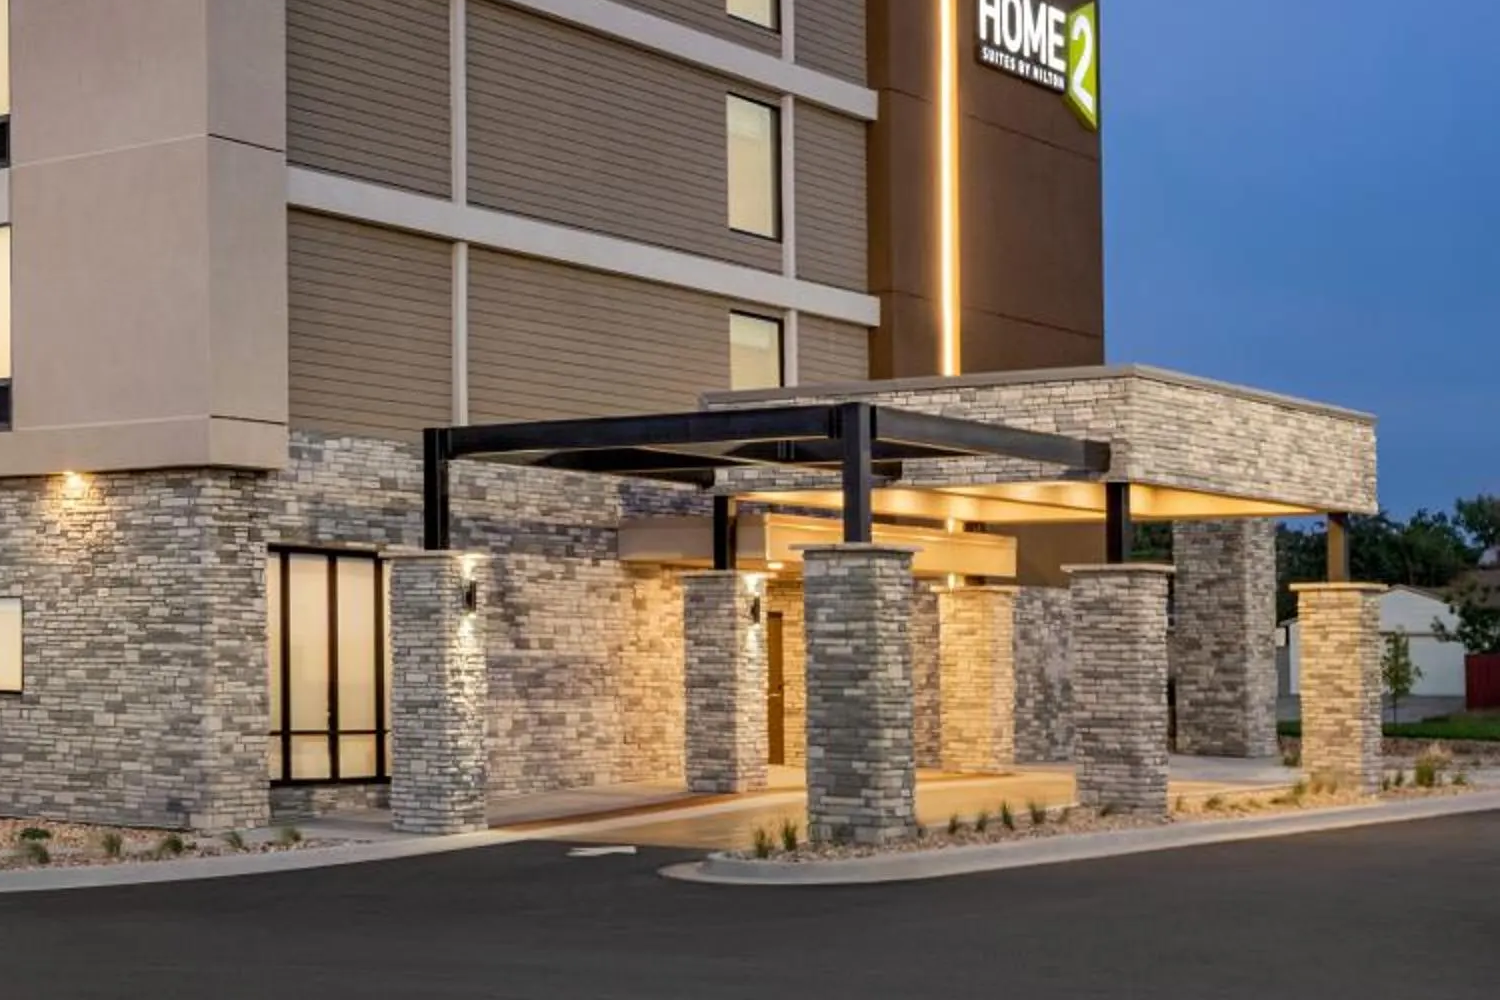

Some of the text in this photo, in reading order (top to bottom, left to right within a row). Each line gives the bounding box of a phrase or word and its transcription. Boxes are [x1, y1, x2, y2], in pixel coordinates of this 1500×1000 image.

[982, 47, 1066, 93] SUITES BY HILTON
